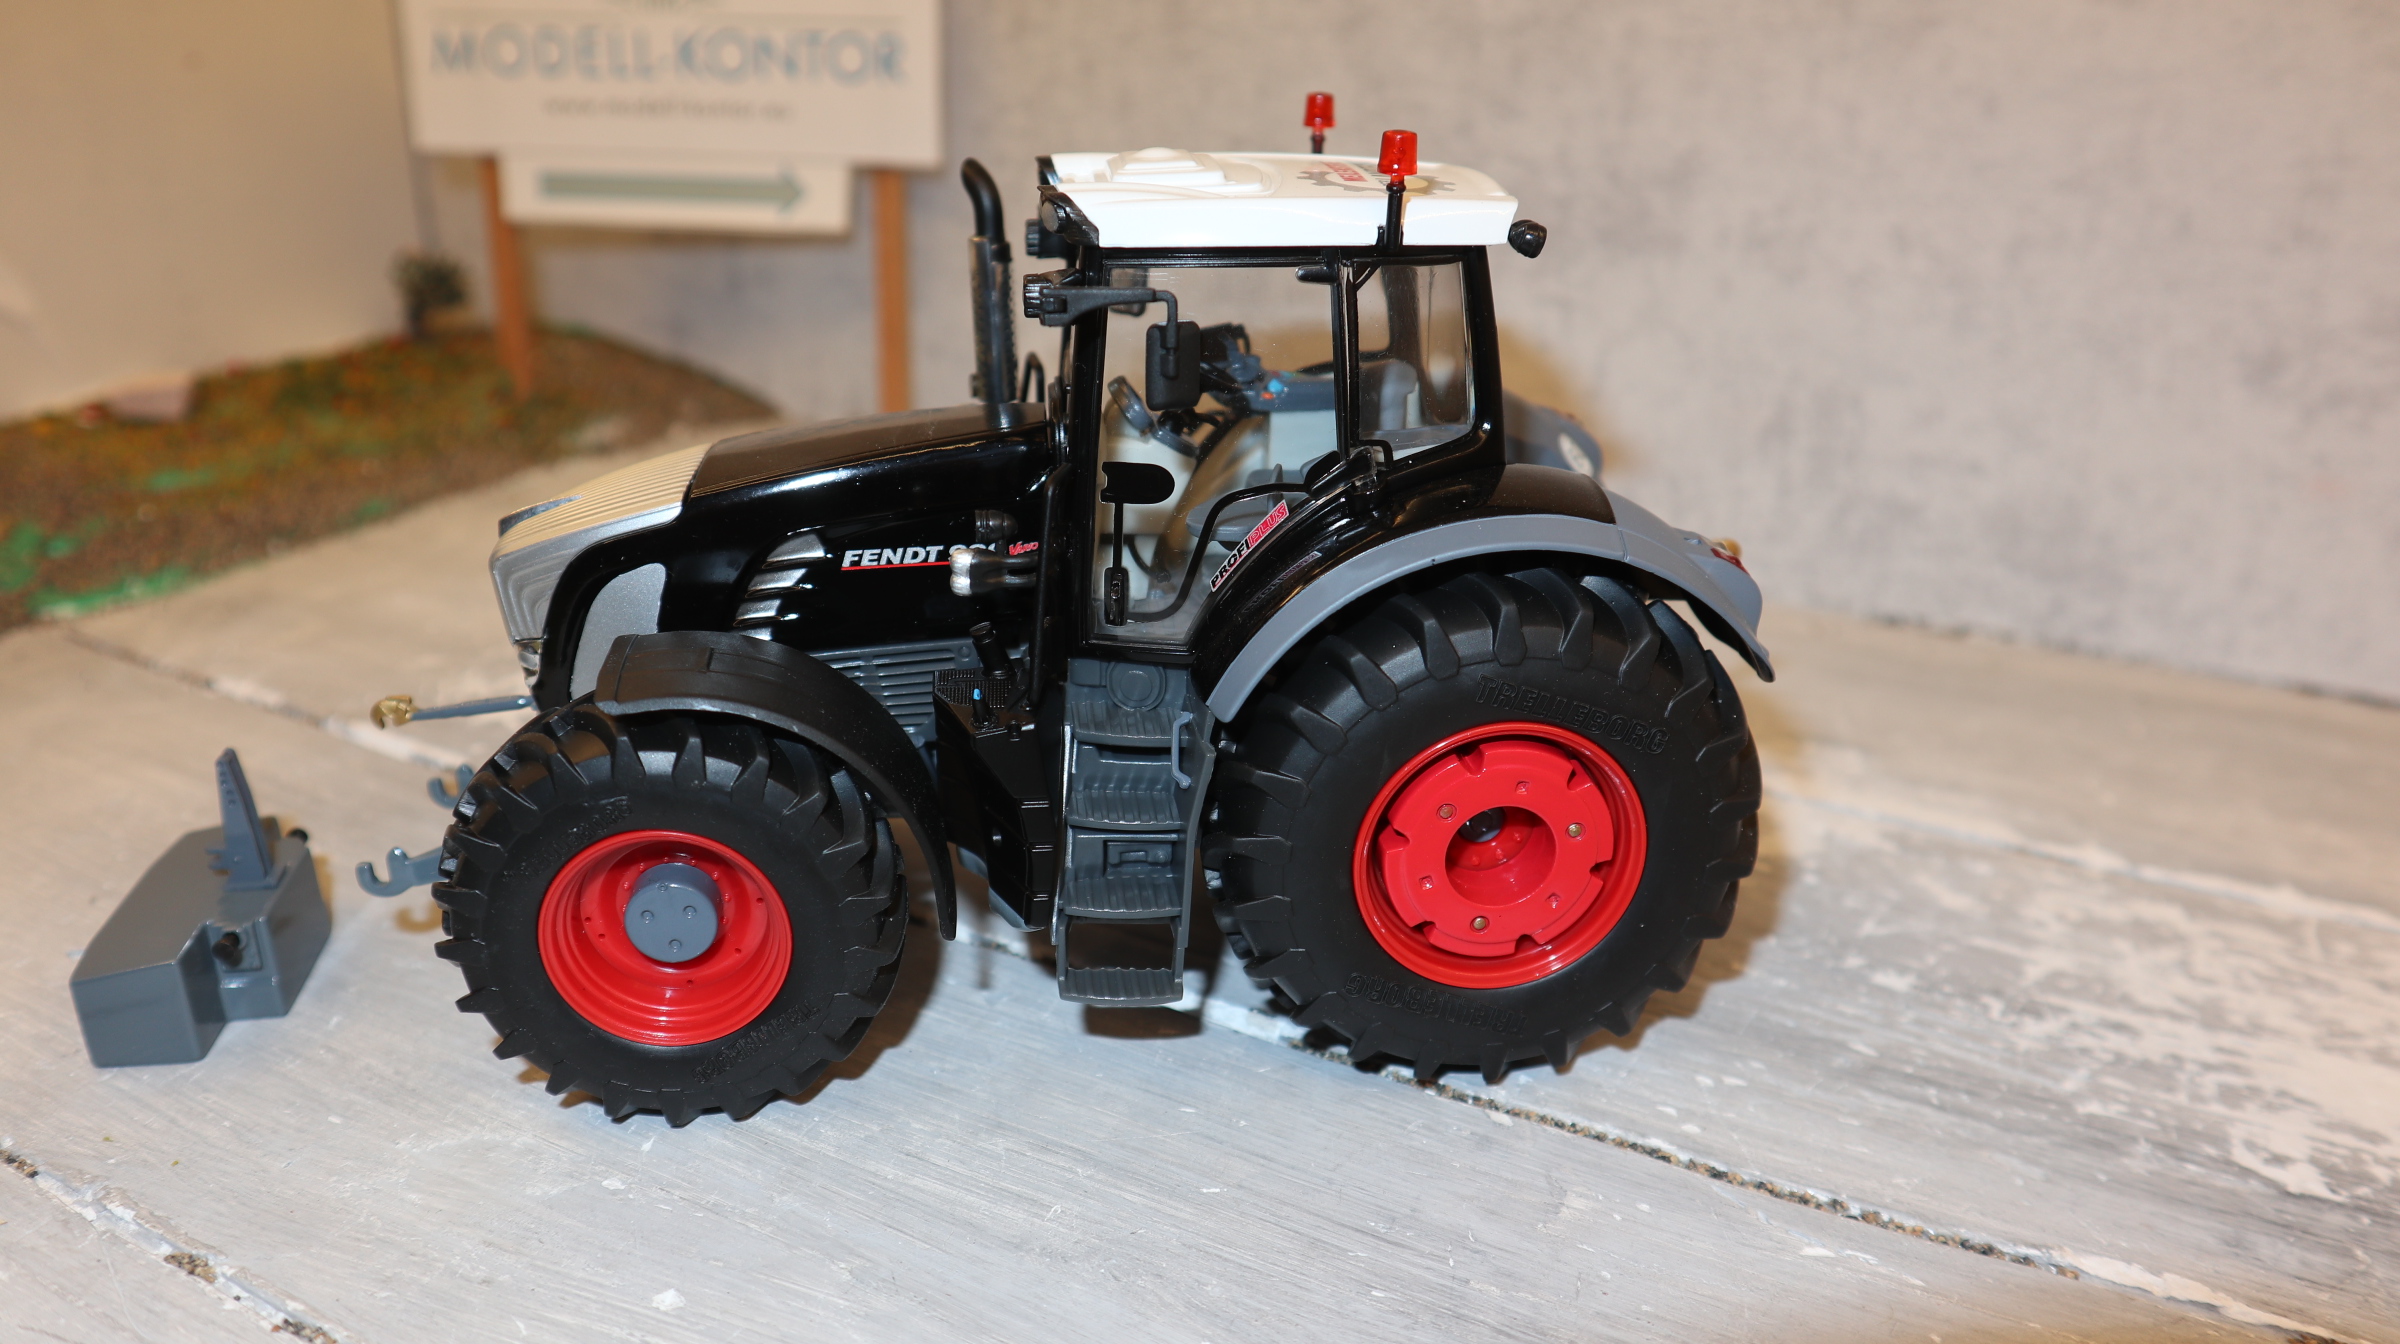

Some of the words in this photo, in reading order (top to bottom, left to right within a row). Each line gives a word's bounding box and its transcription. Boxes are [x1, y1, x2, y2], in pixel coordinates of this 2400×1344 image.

[841, 545, 944, 568] FENDT
[1476, 673, 1671, 754] TRELLEBORG
[1343, 972, 1529, 1036] TRELLEBORG
